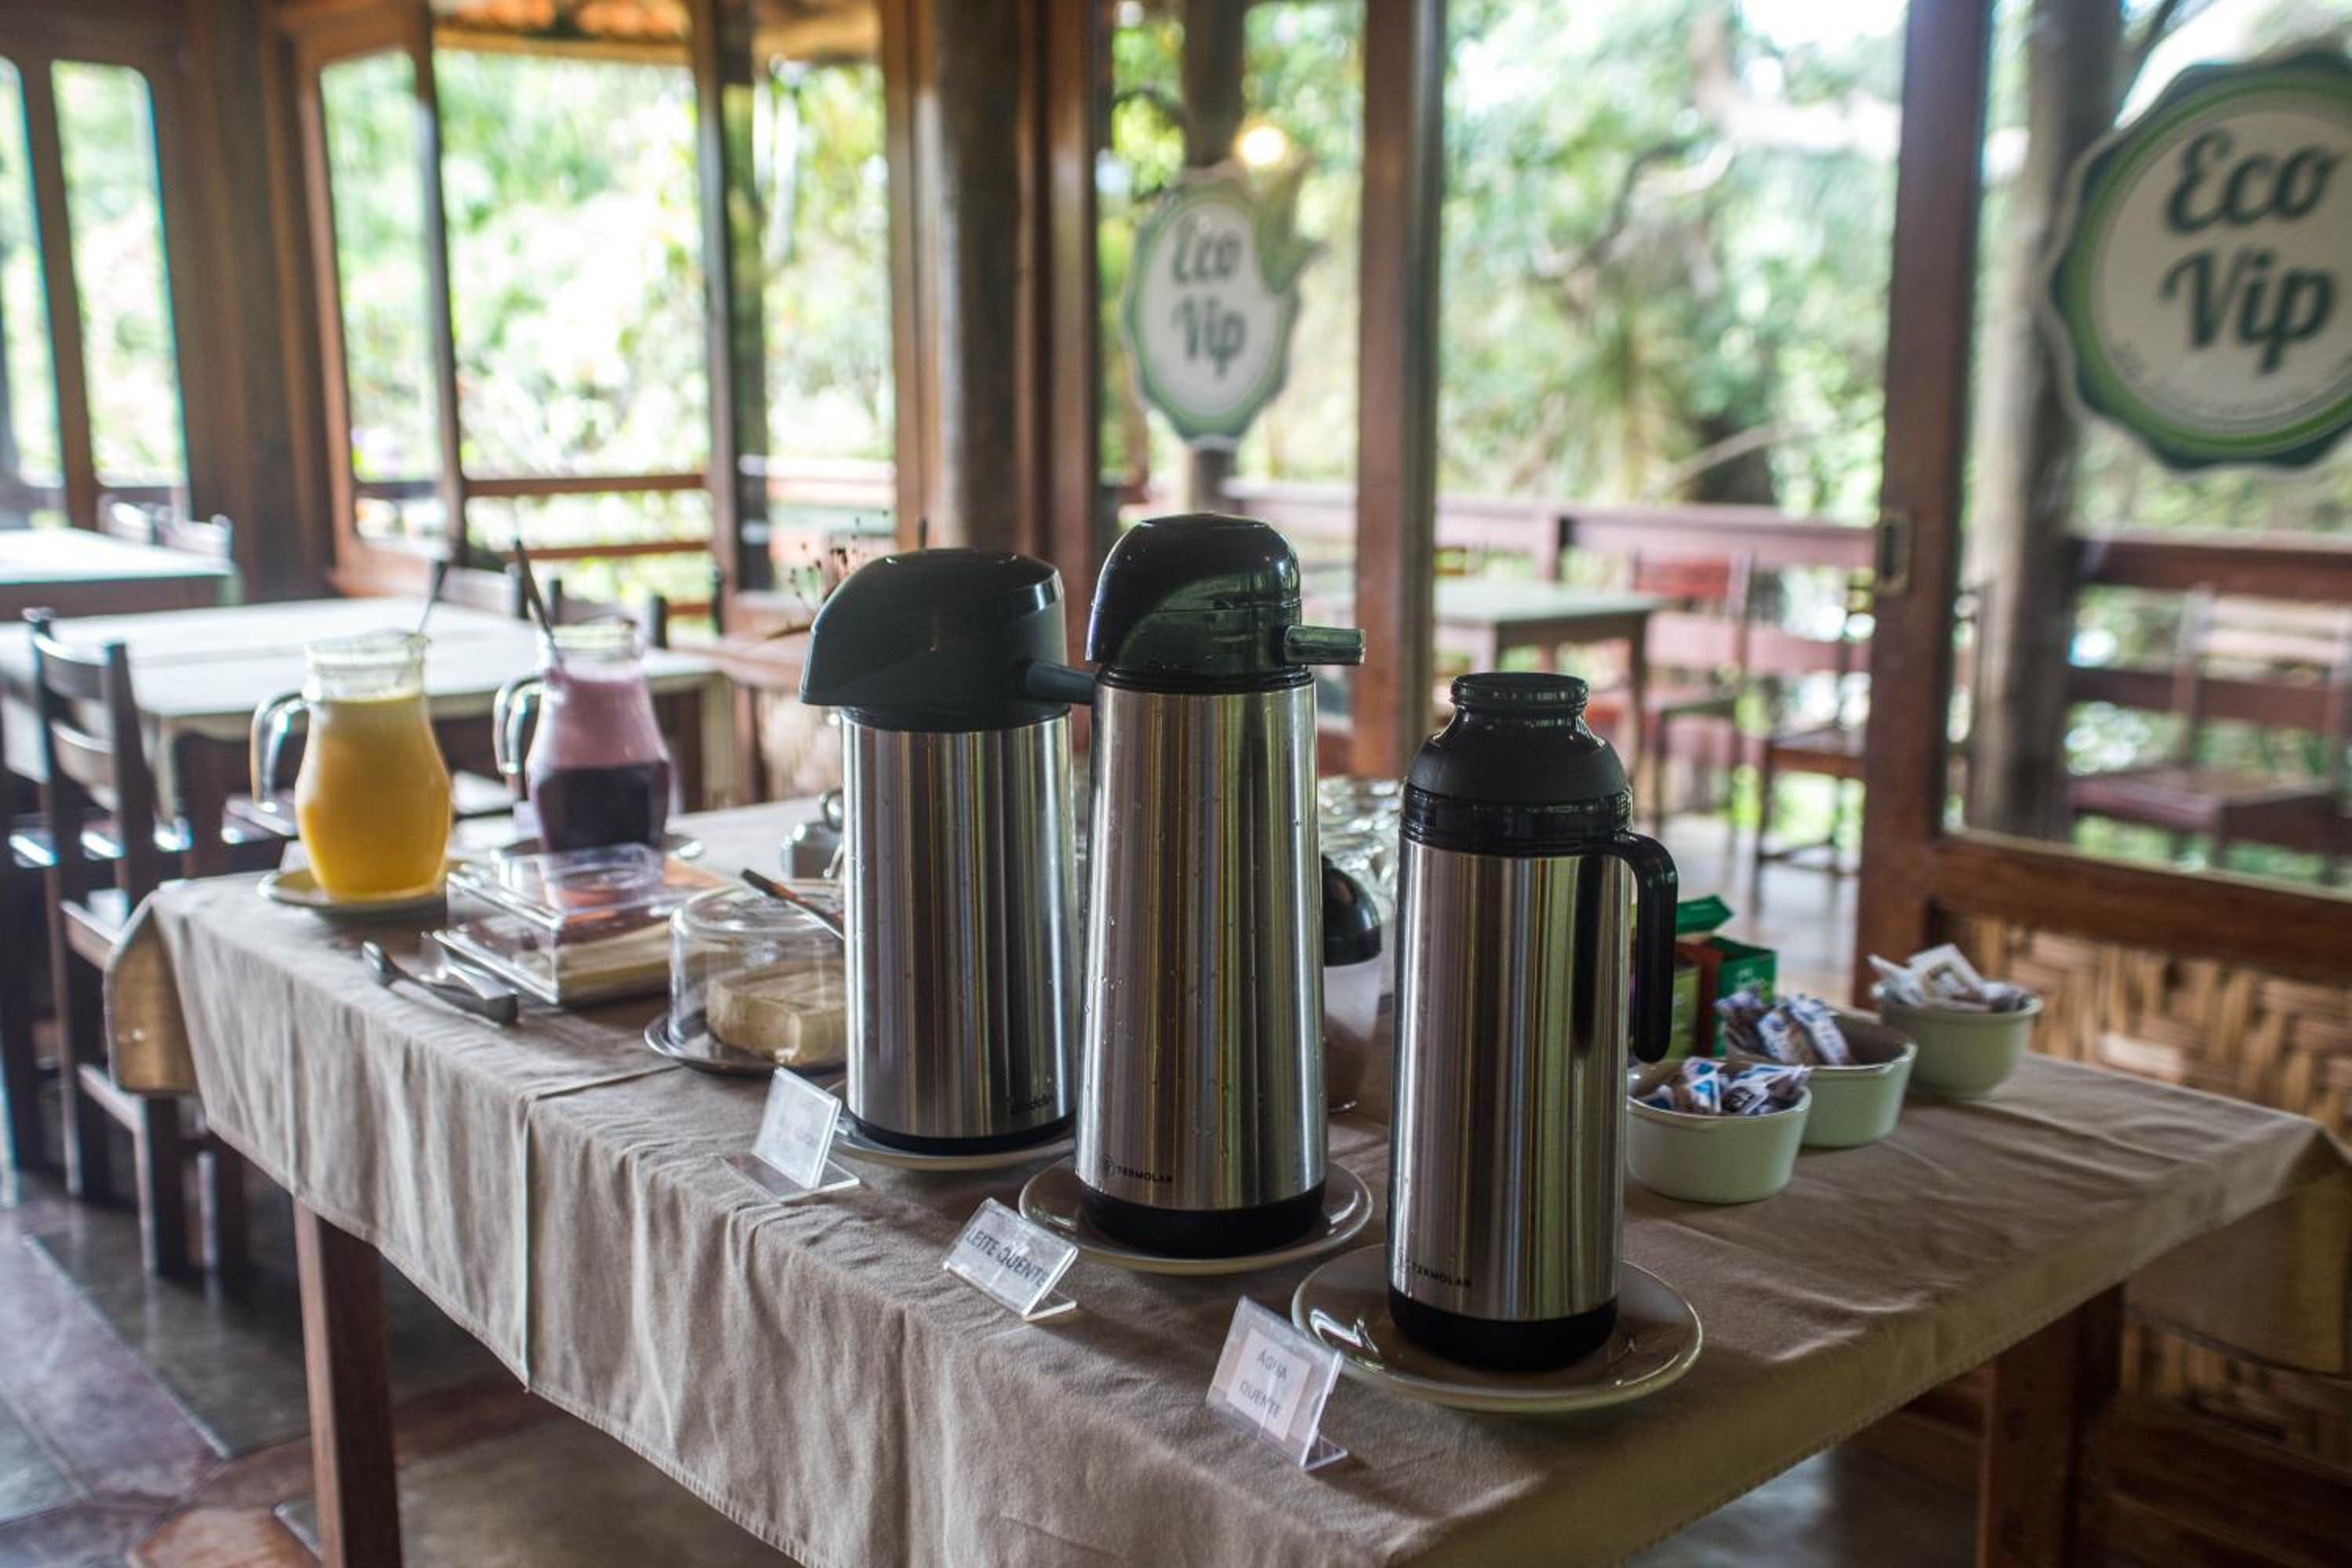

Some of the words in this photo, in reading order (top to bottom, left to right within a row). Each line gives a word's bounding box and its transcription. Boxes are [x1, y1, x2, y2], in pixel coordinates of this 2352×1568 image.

[2165, 129, 2339, 234] Eco
[1171, 212, 1243, 284] Eco
[1171, 293, 1247, 380] Vip
[2160, 248, 2337, 376] Vip
[966, 1229, 1000, 1256] LEITE
[997, 1247, 1051, 1287] QUENTE
